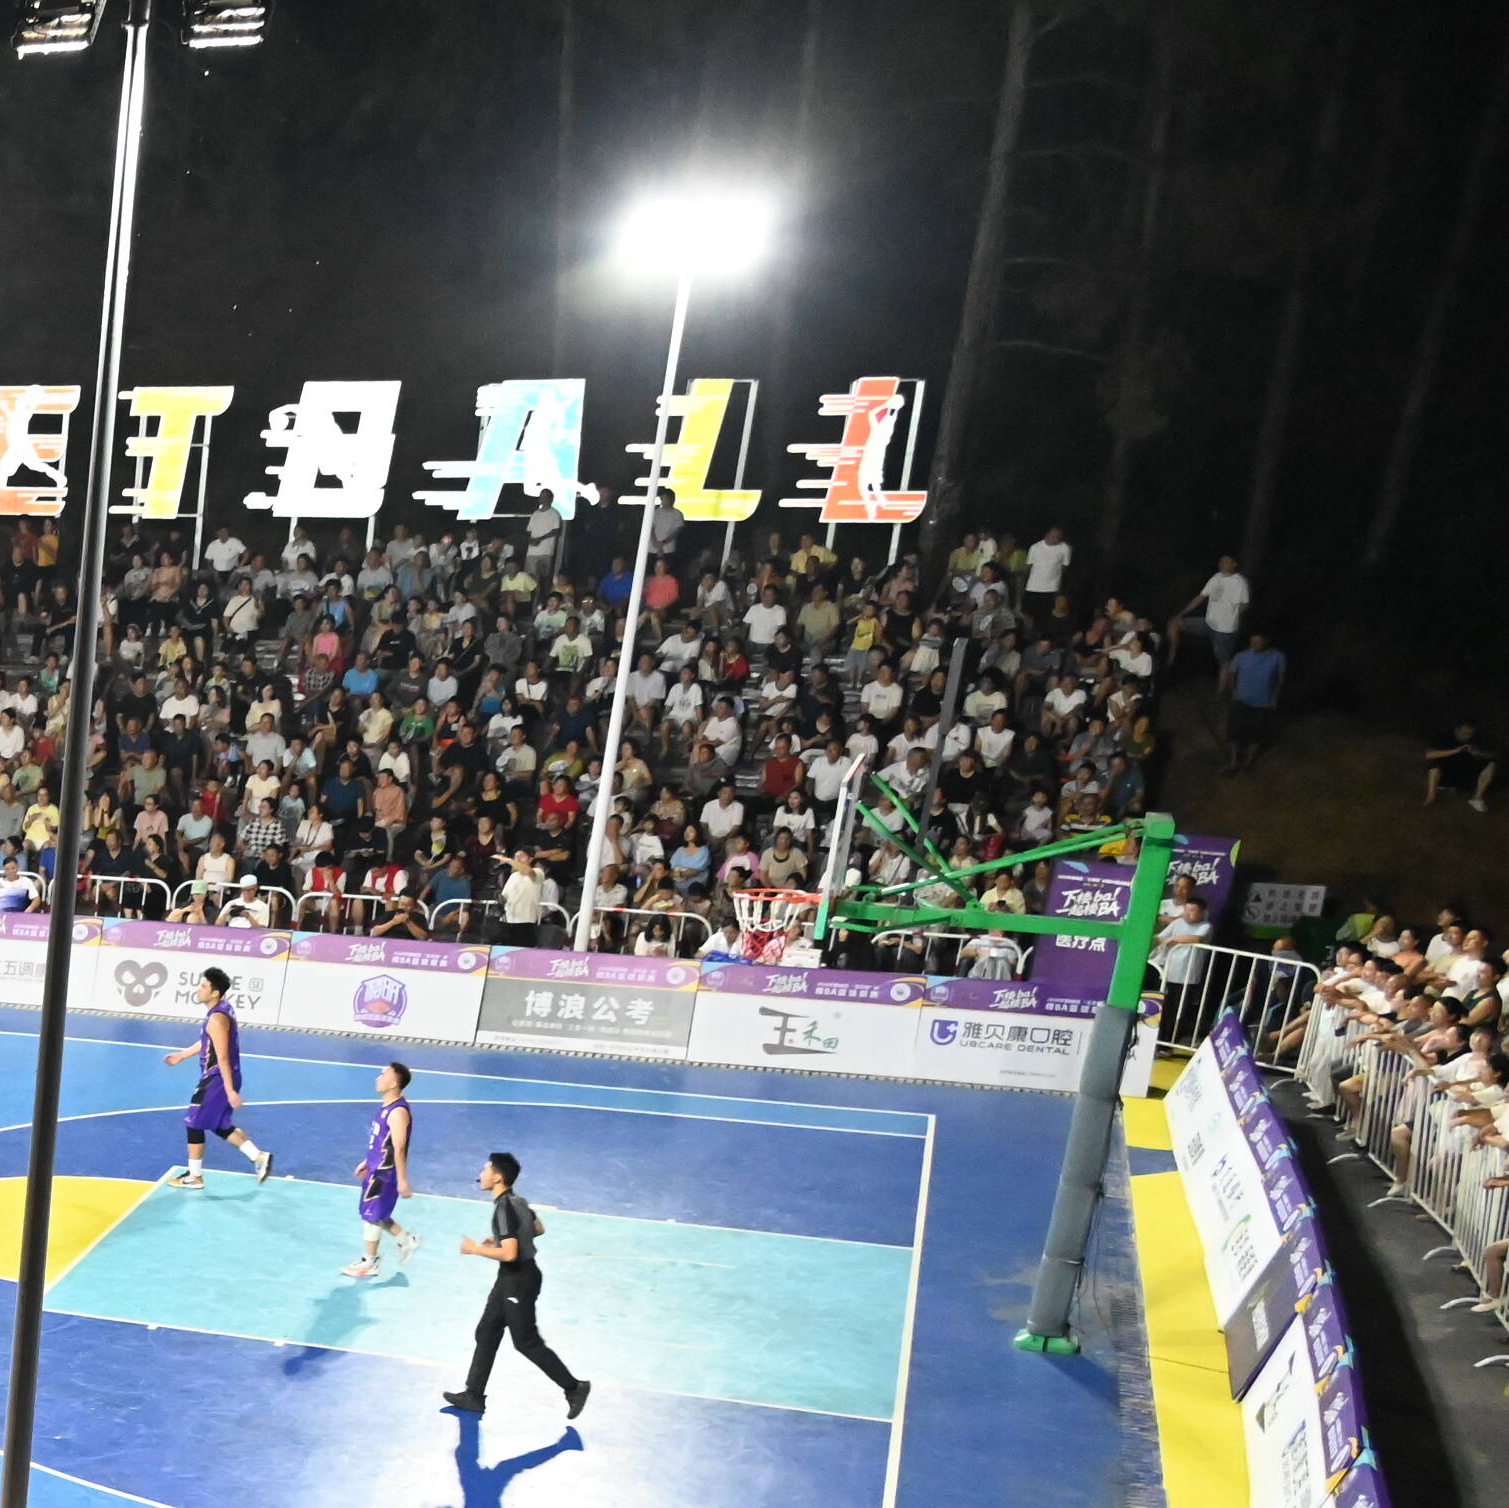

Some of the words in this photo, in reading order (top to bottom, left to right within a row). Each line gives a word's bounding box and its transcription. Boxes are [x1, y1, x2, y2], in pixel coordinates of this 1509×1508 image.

[1062, 888, 1121, 907] 下楼ba!
[1056, 902, 1121, 917] 一起楼BA
[1055, 935, 1106, 952] 医疗点
[178, 971, 243, 991] SUE
[174, 989, 261, 1012] MOKEY
[525, 990, 654, 1025] 博浪公考
[962, 1021, 1074, 1047] 雅贝康口腔
[959, 1039, 1012, 1051] UBCARE
[1017, 1044, 1070, 1056] DENTAL
